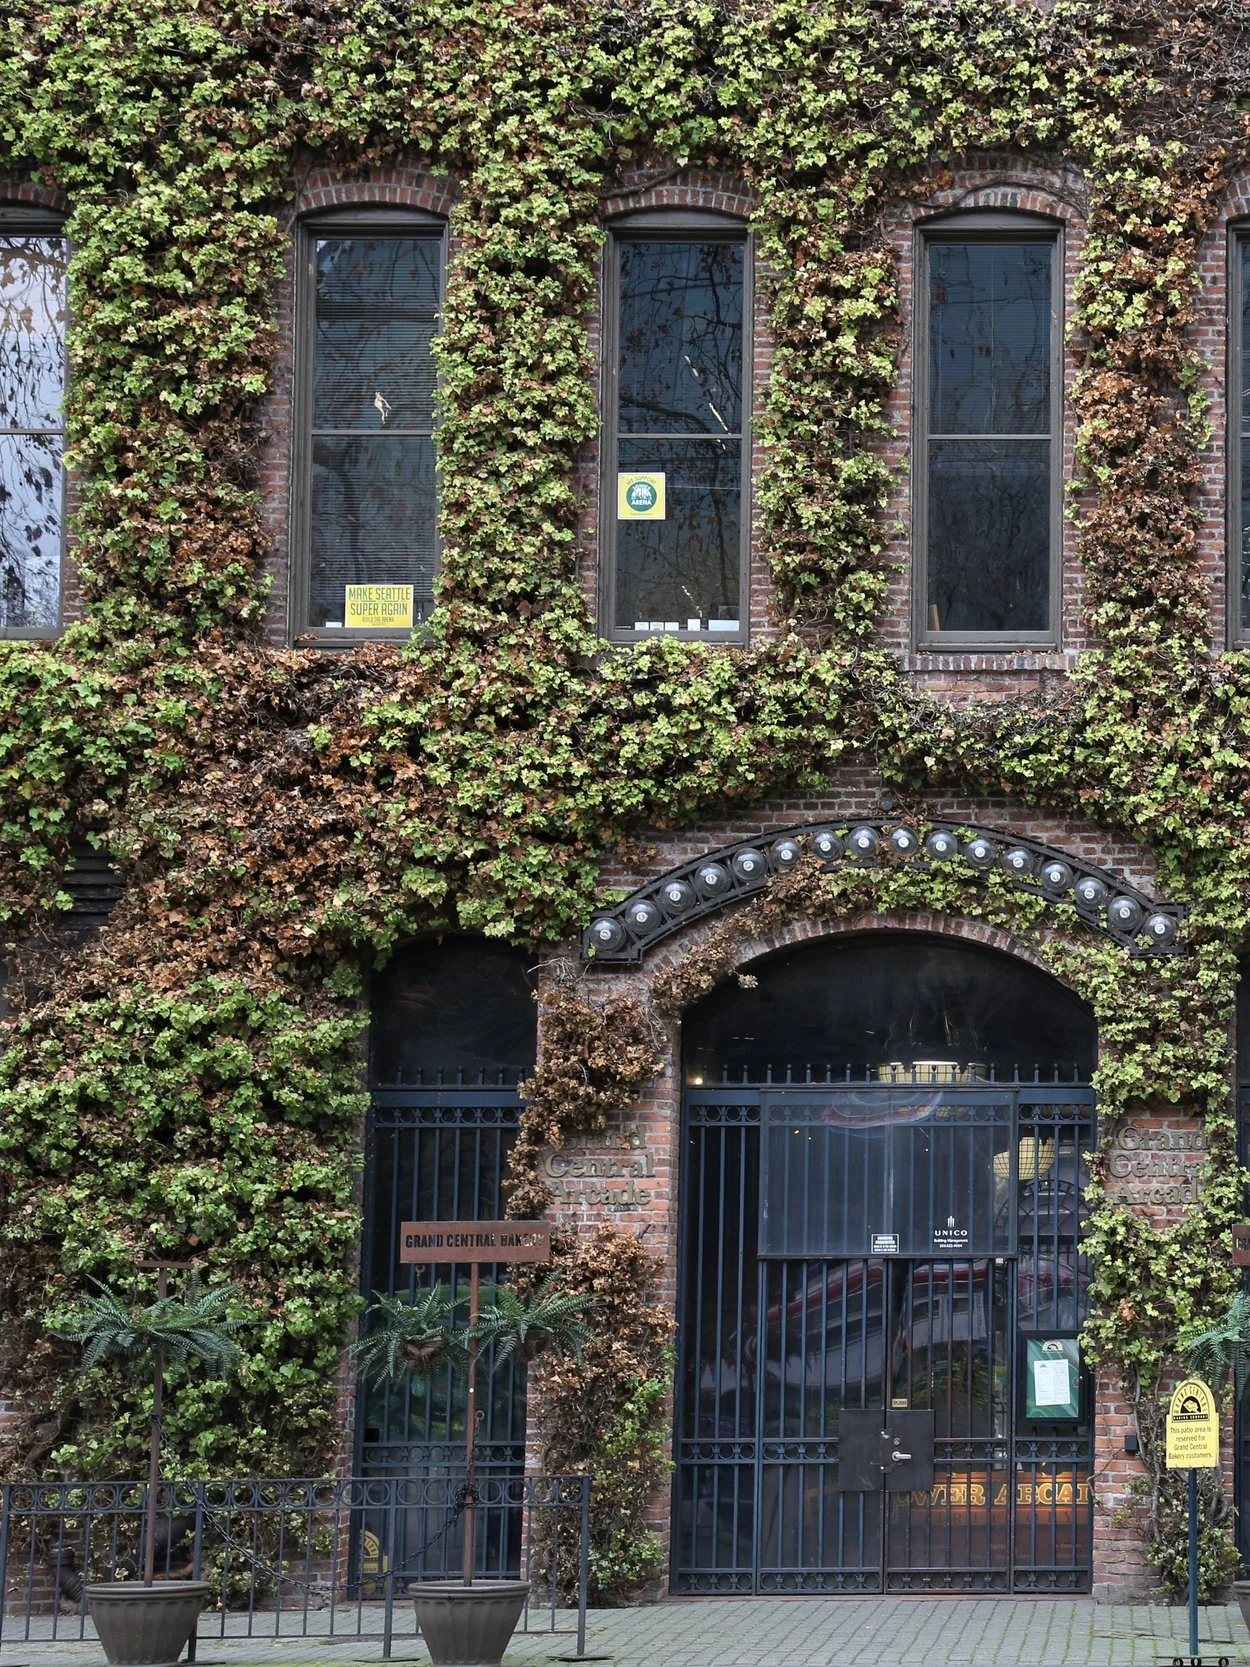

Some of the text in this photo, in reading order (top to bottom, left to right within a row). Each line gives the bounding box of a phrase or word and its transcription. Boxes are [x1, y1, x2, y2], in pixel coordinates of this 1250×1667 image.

[635, 476, 656, 484] SUPPORT
[349, 587, 411, 600] MAKE SEATTLE
[350, 602, 408, 616] SUPER AGAIN
[1118, 1125, 1210, 1151] Grand
[544, 1152, 656, 1178] Central
[1109, 1154, 1205, 1178] Centra
[550, 1180, 651, 1205] Arcade
[1112, 1180, 1200, 1205] Arcad
[406, 1234, 444, 1248] GRAND
[446, 1234, 496, 1247] CENTRAL
